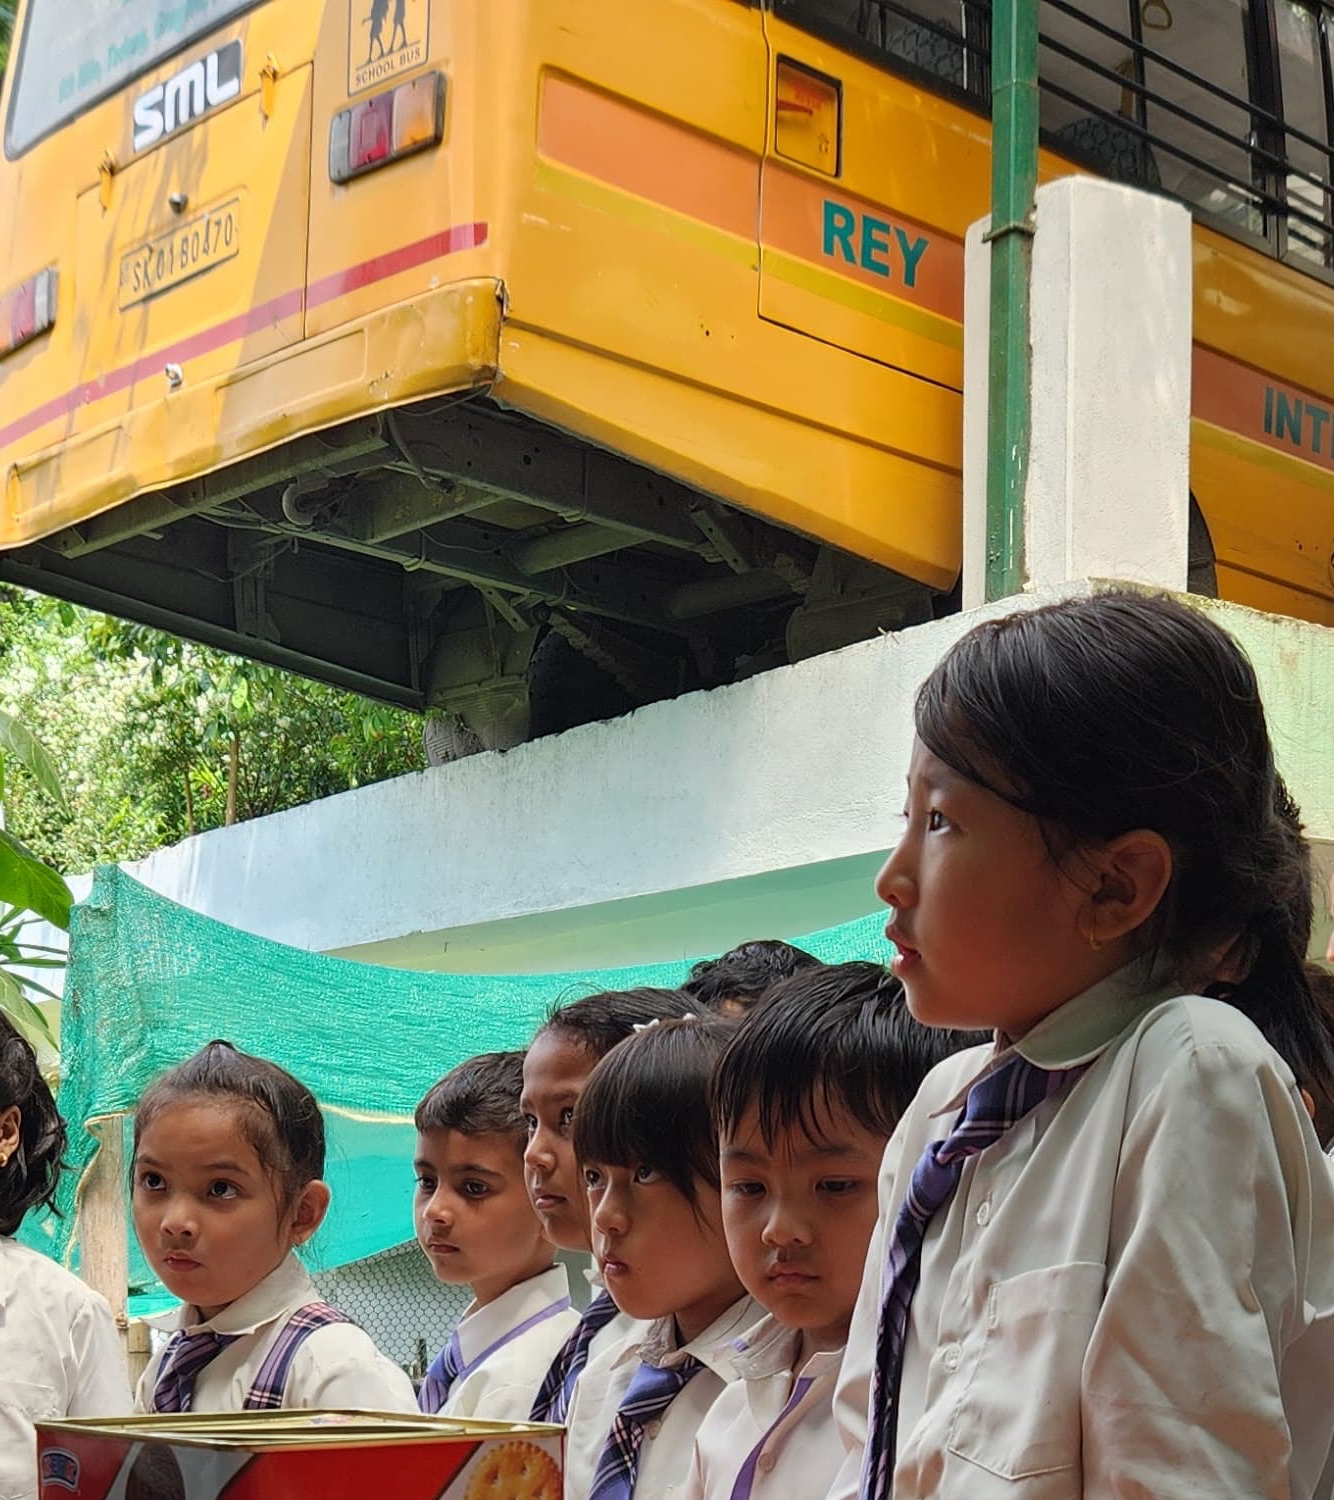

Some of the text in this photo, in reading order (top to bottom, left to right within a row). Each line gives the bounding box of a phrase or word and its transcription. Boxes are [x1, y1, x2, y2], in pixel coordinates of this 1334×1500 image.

[355, 46, 421, 88] SCHOOL BUS
[823, 198, 930, 289] REY
